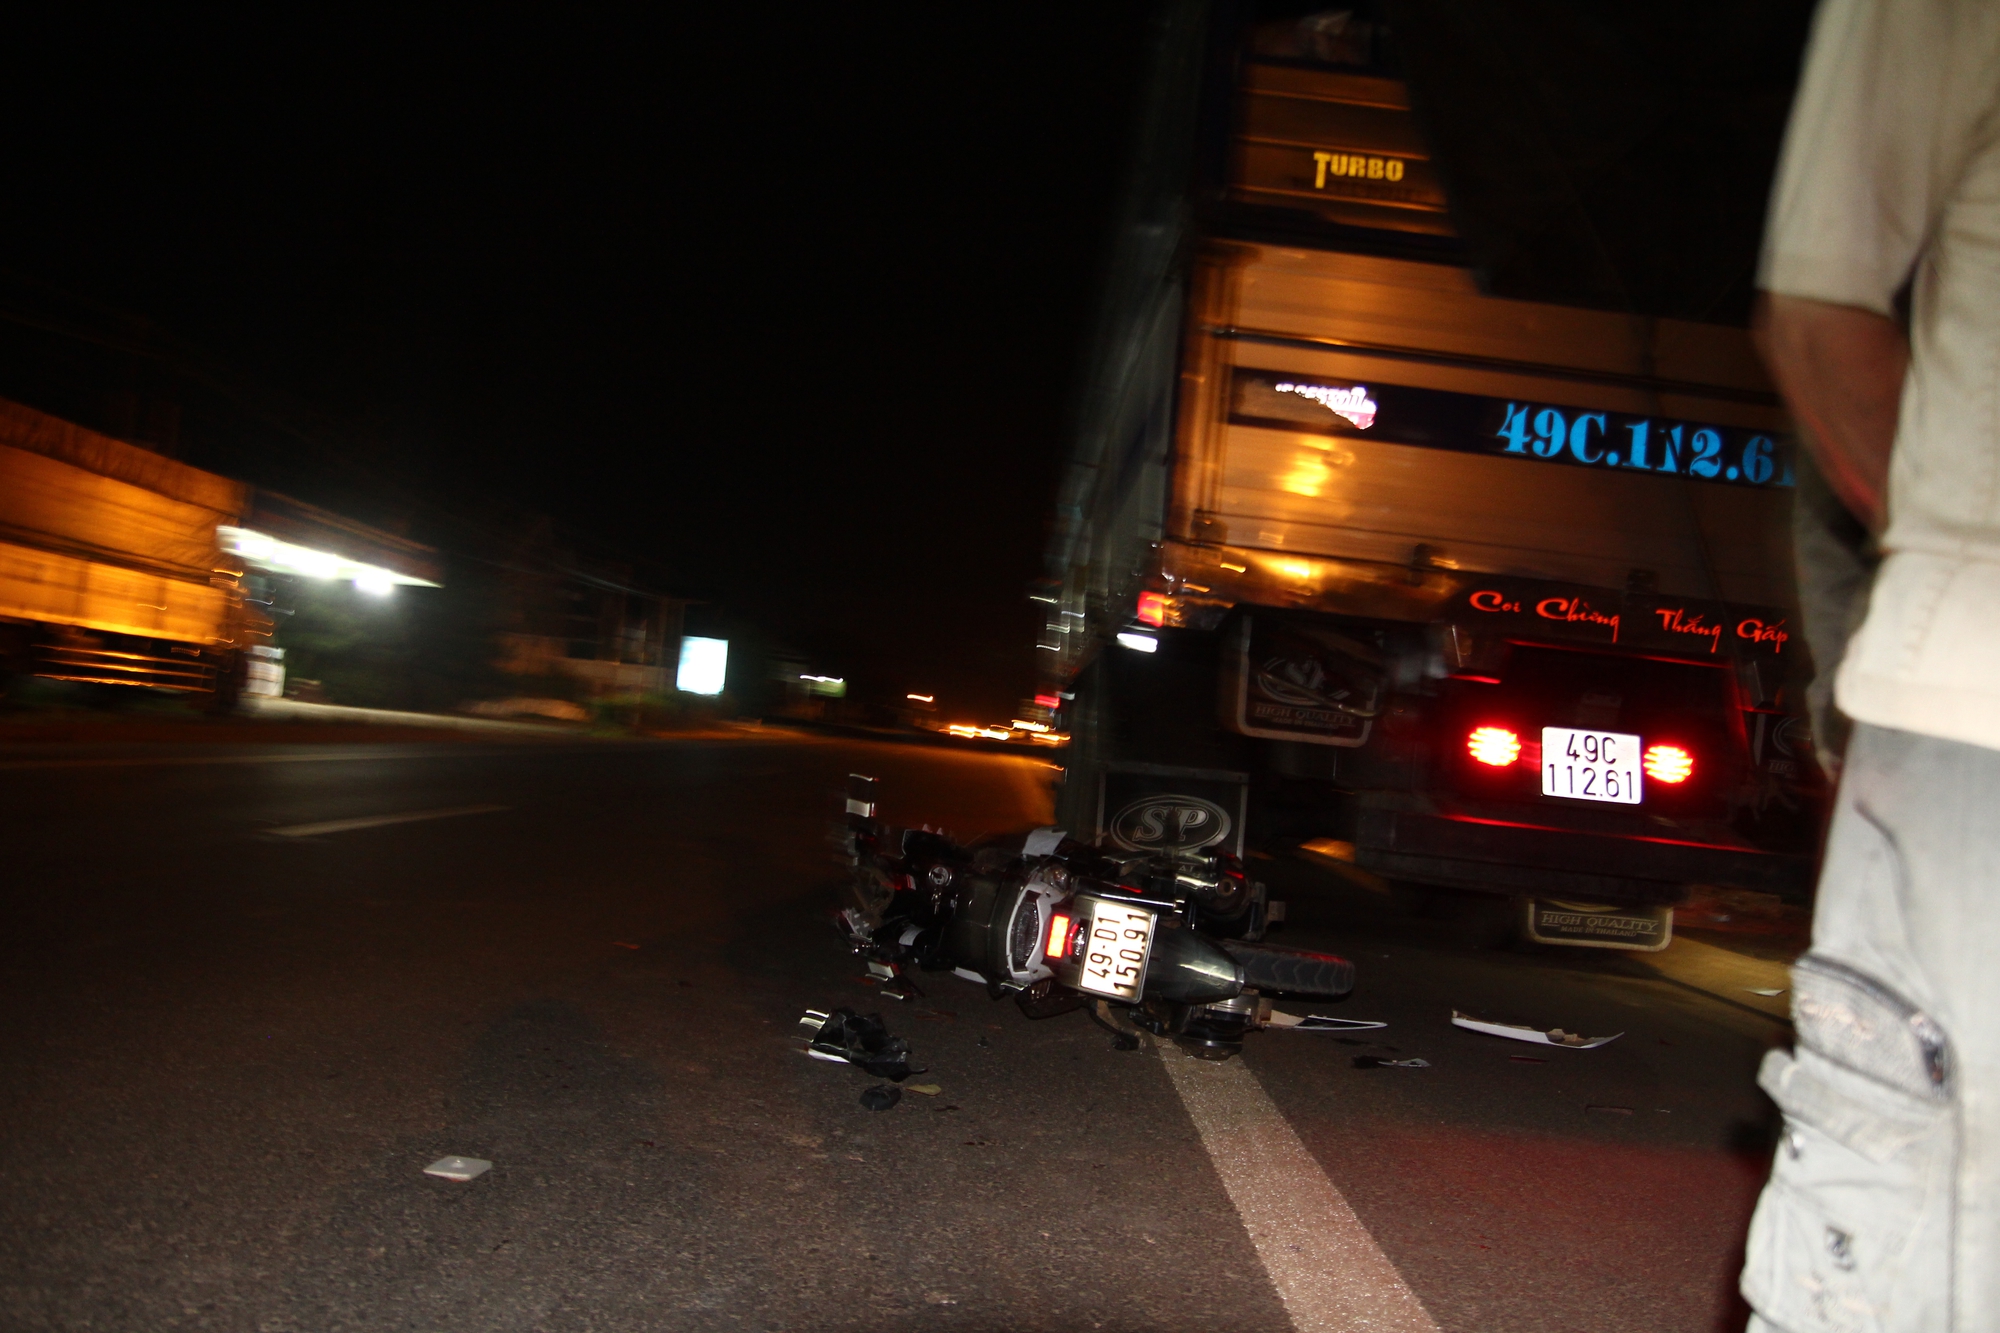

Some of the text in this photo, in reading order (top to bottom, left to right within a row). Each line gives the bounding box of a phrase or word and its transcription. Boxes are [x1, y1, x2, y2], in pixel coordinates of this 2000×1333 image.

[1313, 150, 1405, 189] TURBO
[1469, 590, 1521, 613] Coi
[1655, 608, 1722, 654] Thắng
[1736, 618, 1789, 654] Gấp
[1255, 705, 1356, 726] HIGH QUALITY
[1566, 733, 1617, 765] 49C
[1548, 764, 1633, 801] 112.61
[1131, 805, 1210, 842] SP
[1541, 913, 1659, 932] HIGH QUALITY
[1560, 925, 1638, 938] MADE IN THAILAND
[1113, 913, 1151, 990] 150.91
